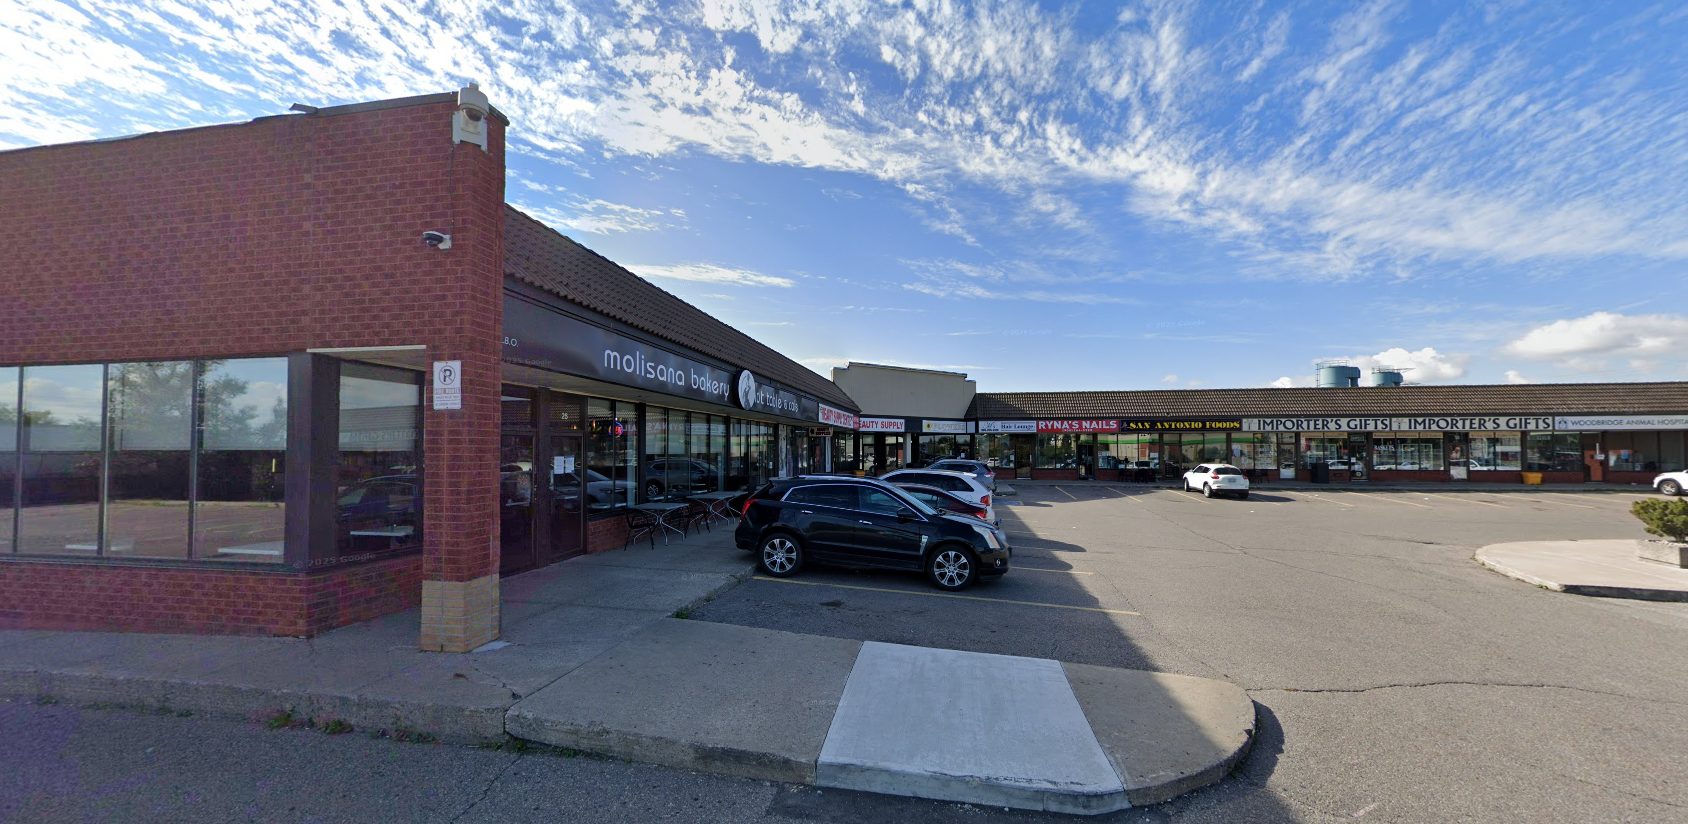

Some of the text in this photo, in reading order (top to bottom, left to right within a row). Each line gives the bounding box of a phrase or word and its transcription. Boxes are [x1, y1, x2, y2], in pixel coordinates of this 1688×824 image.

[604, 349, 730, 401] molisana bakery
[859, 420, 904, 430] EAUTY SUPPLY
[1038, 420, 1117, 430] RYNA'S NAILS
[1129, 421, 1240, 430] SAN ANTONIO FOODS
[1257, 418, 1389, 431] IMPORTER'S GIFTS
[1408, 417, 1551, 431] IMPORTER'S GIFTS
[1571, 419, 1624, 427] WOODBRIDGE
